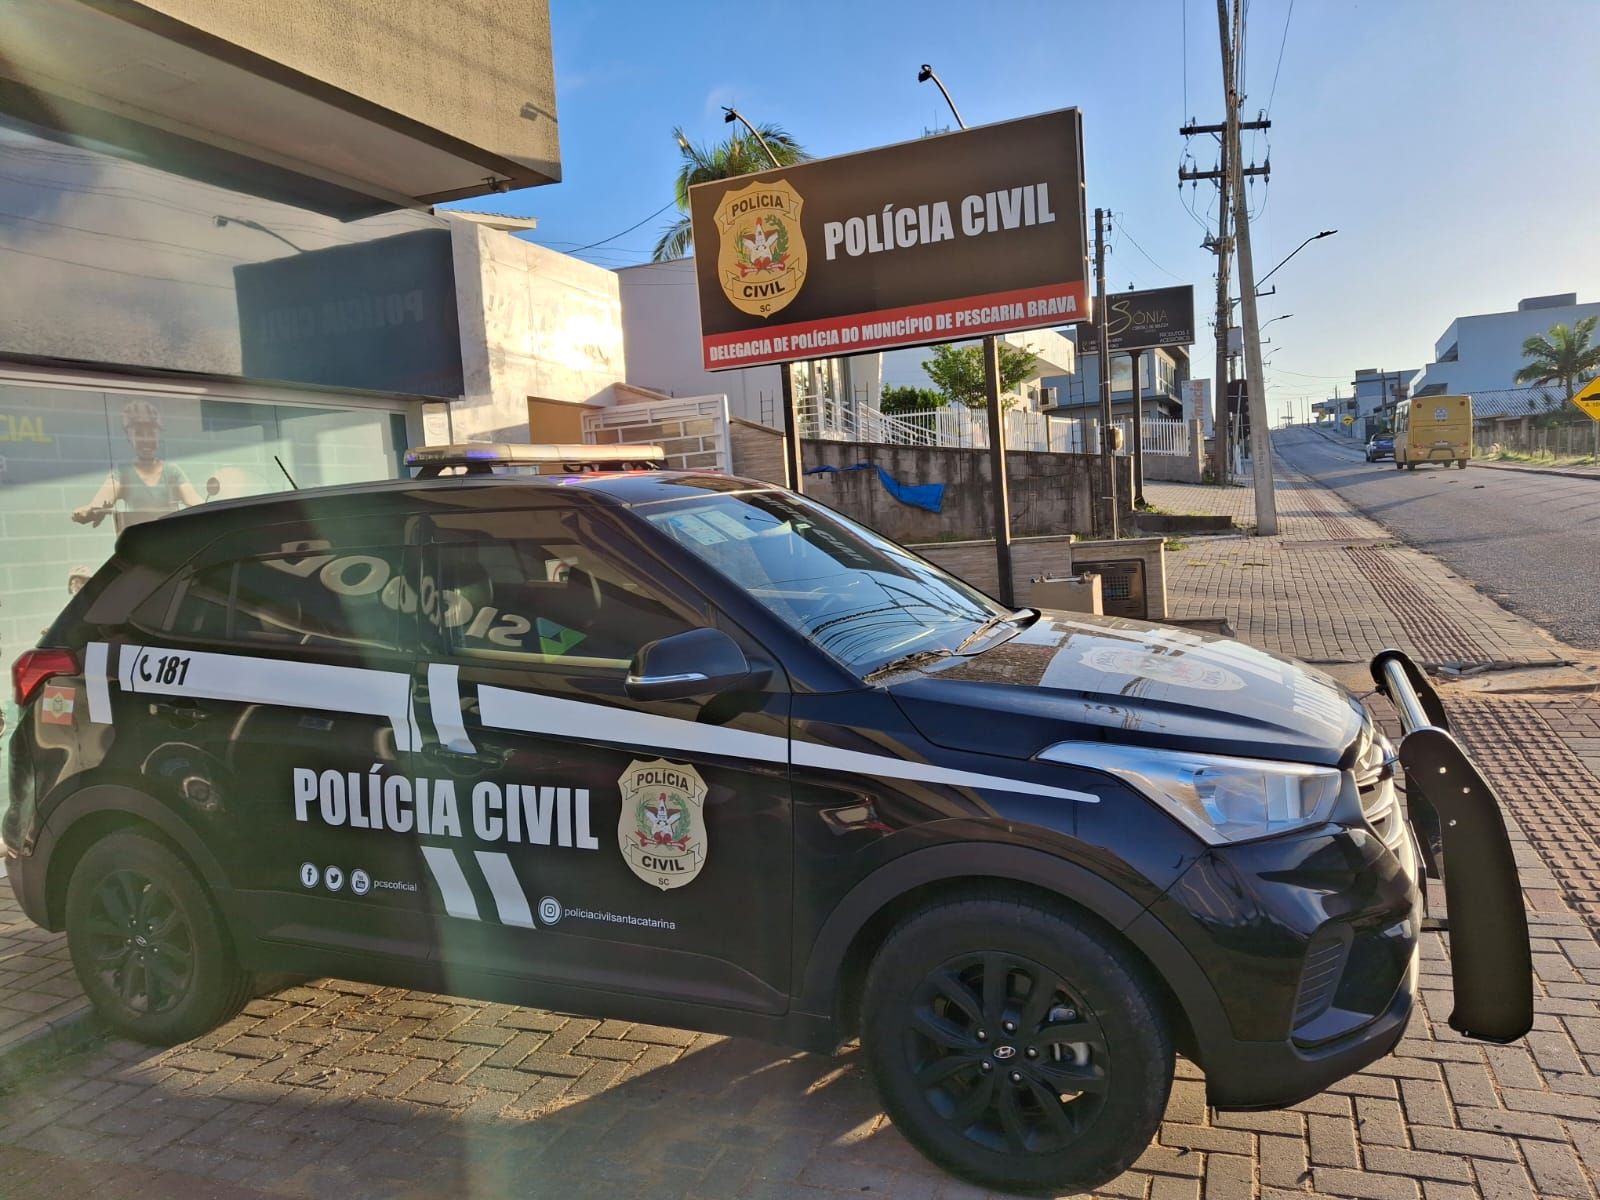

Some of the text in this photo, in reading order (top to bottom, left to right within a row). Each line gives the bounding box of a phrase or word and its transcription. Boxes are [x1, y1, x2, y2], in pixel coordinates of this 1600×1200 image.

[731, 192, 784, 217] POLÍCIA
[823, 182, 1056, 261] POLÍCIA CIVIL
[743, 281, 785, 298] CIVIL
[760, 303, 771, 313] SC
[709, 295, 1077, 362] DELEGACIA DE POLÍCIA DO MUNICÍPIO DE PESCARIA BRAVA
[155, 655, 191, 686] 181
[636, 769, 689, 791] POLÍCIA
[293, 763, 599, 850] POLÍCIA CIVIL
[641, 855, 685, 871] CIVIL
[373, 880, 418, 892] pcscoficial
[658, 877, 670, 886] SC
[564, 908, 676, 930] policiacivilsantacatarina
